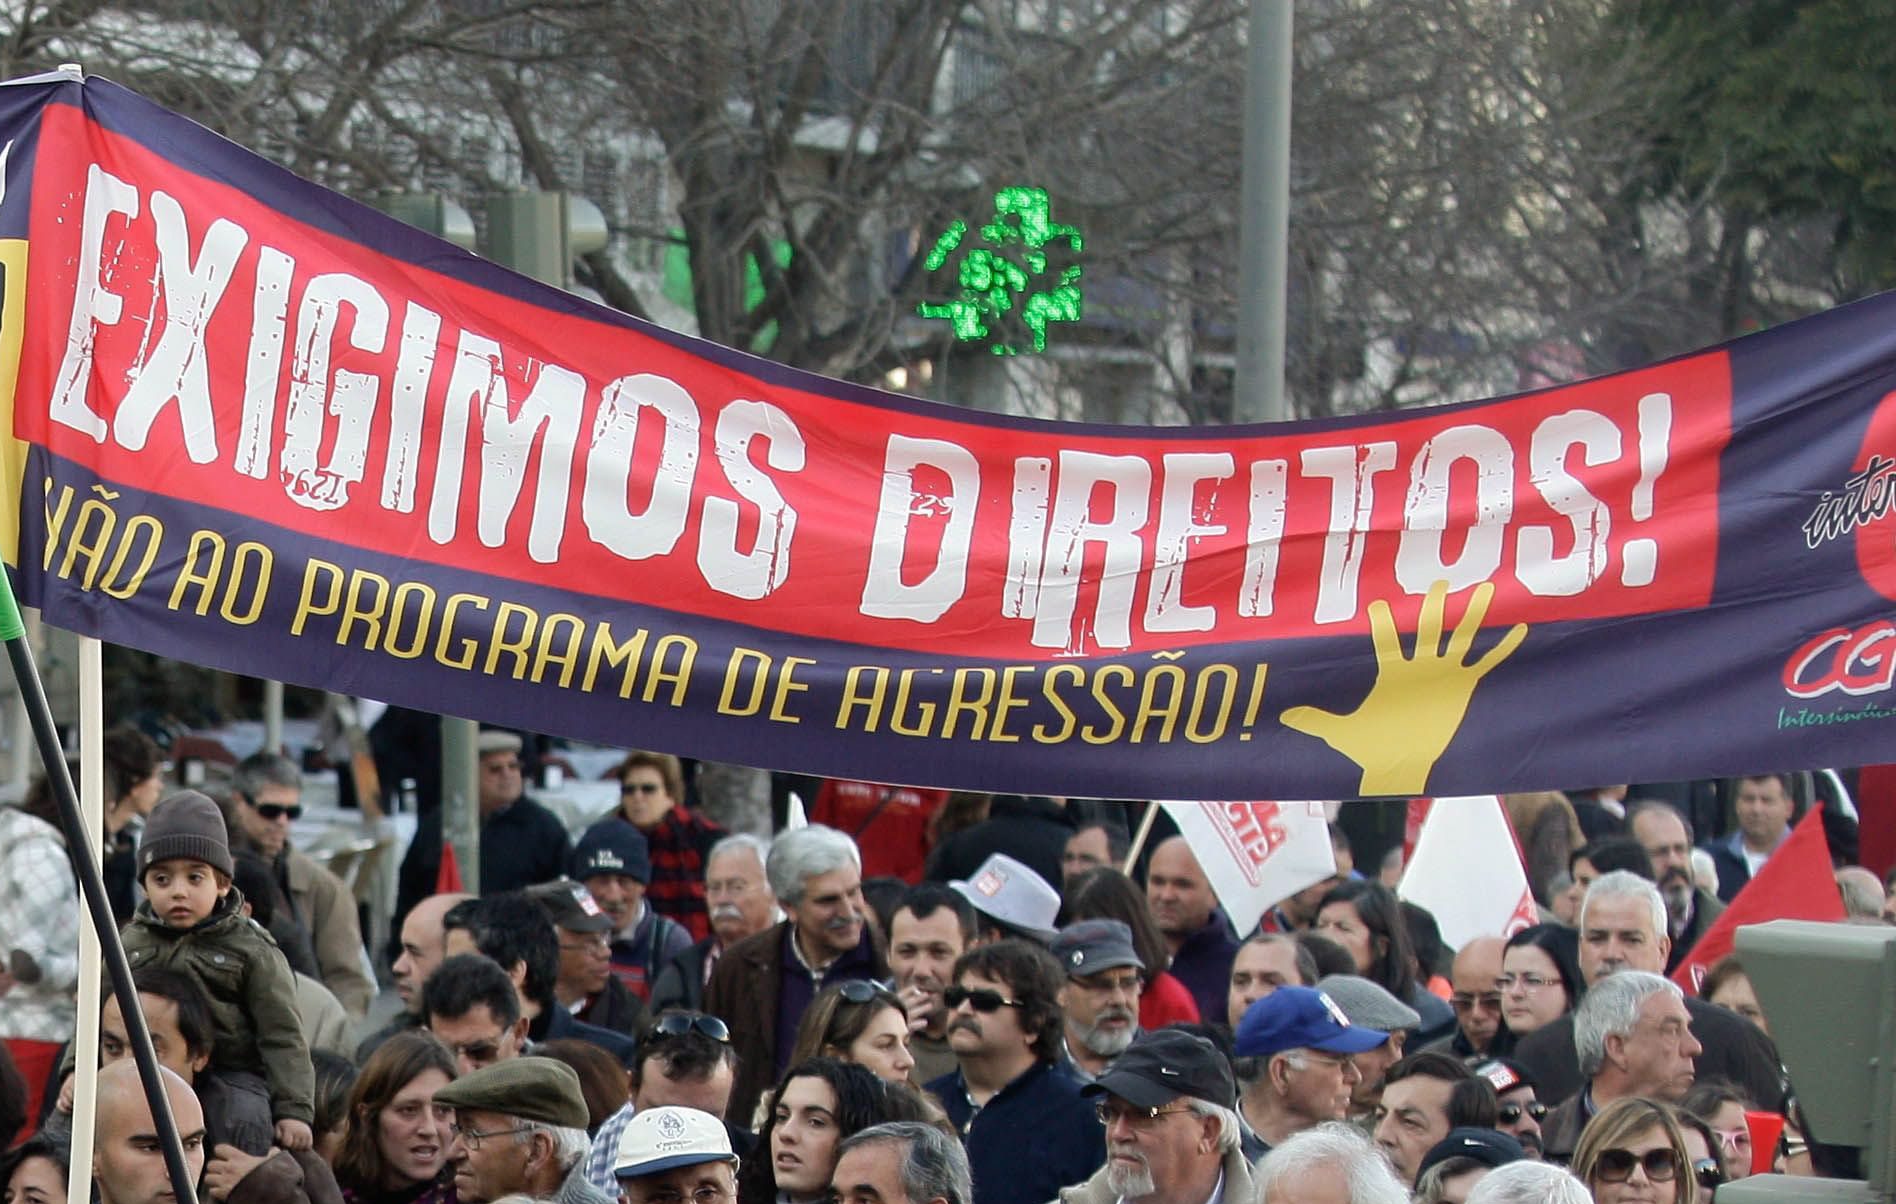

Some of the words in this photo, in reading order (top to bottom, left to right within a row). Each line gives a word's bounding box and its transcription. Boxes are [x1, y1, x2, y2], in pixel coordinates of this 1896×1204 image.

[49, 162, 806, 600] EXIGIMOS
[43, 476, 163, 600] NÃO
[168, 530, 274, 626] AO
[290, 557, 697, 708] PROGRAMA
[716, 645, 811, 724] DE
[834, 649, 1270, 746] AGRESSÃO!
[858, 391, 1673, 655] DIREITOS!
